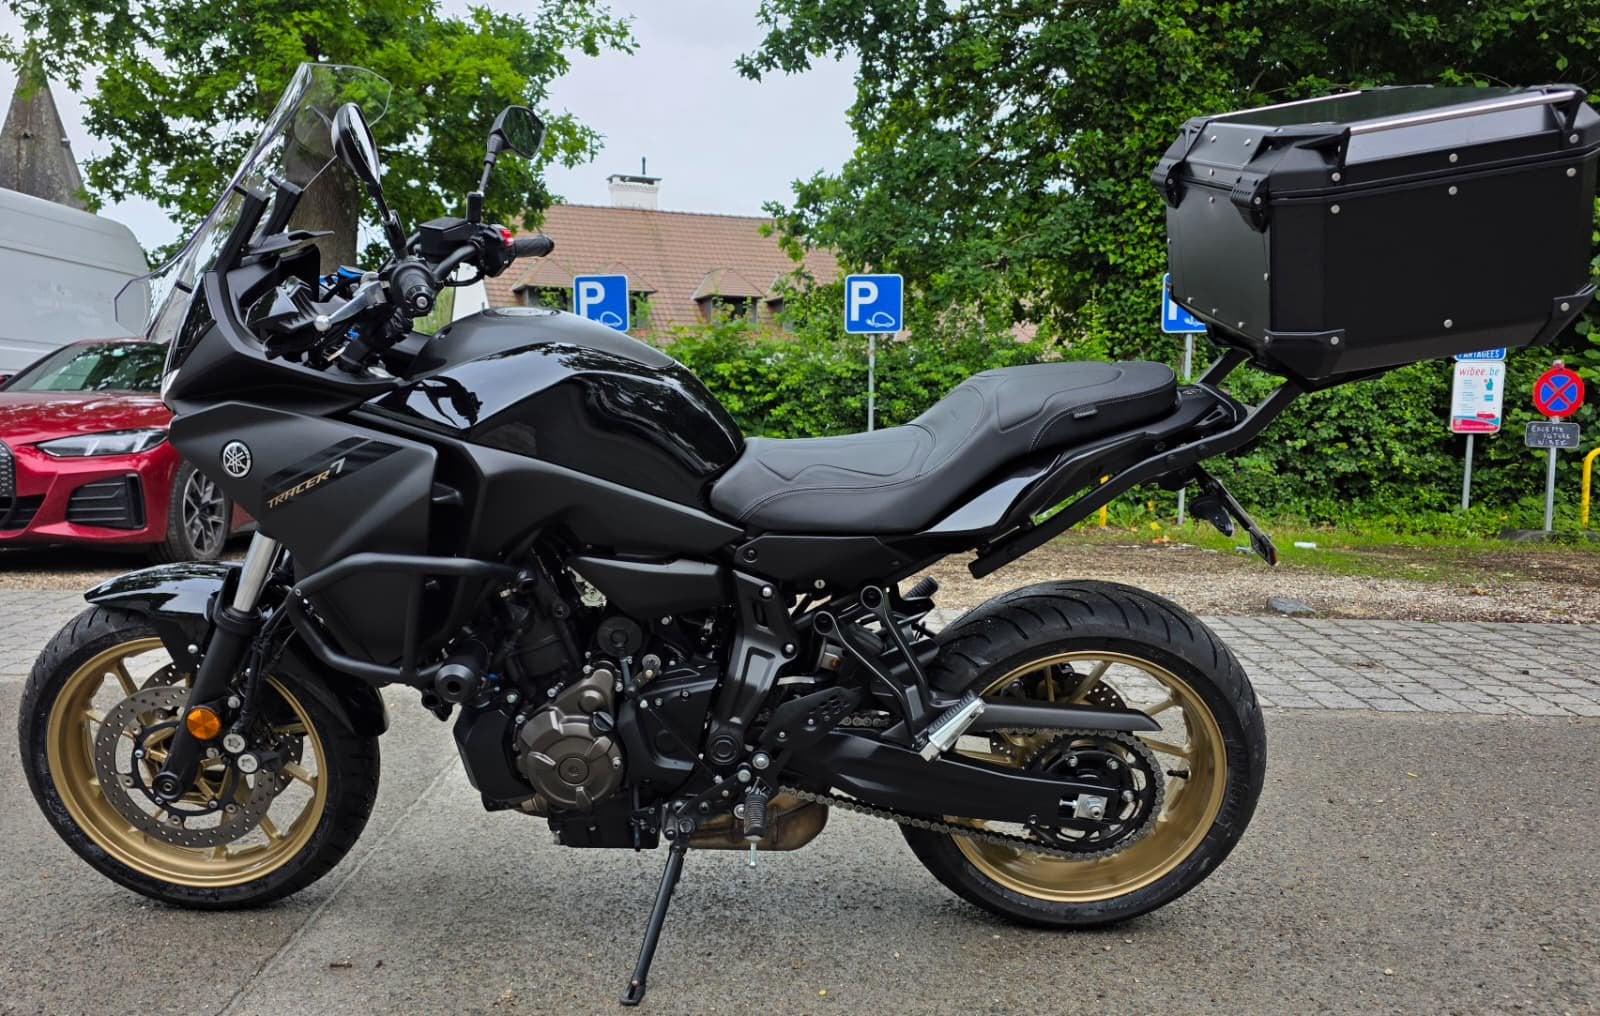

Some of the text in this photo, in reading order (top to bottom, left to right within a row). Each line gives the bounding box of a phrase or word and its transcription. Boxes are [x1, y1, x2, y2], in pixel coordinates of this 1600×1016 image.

[579, 281, 605, 319] P
[851, 281, 878, 321] P
[1459, 368, 1500, 377] wibee.be
[267, 457, 346, 508] TRACER 7
